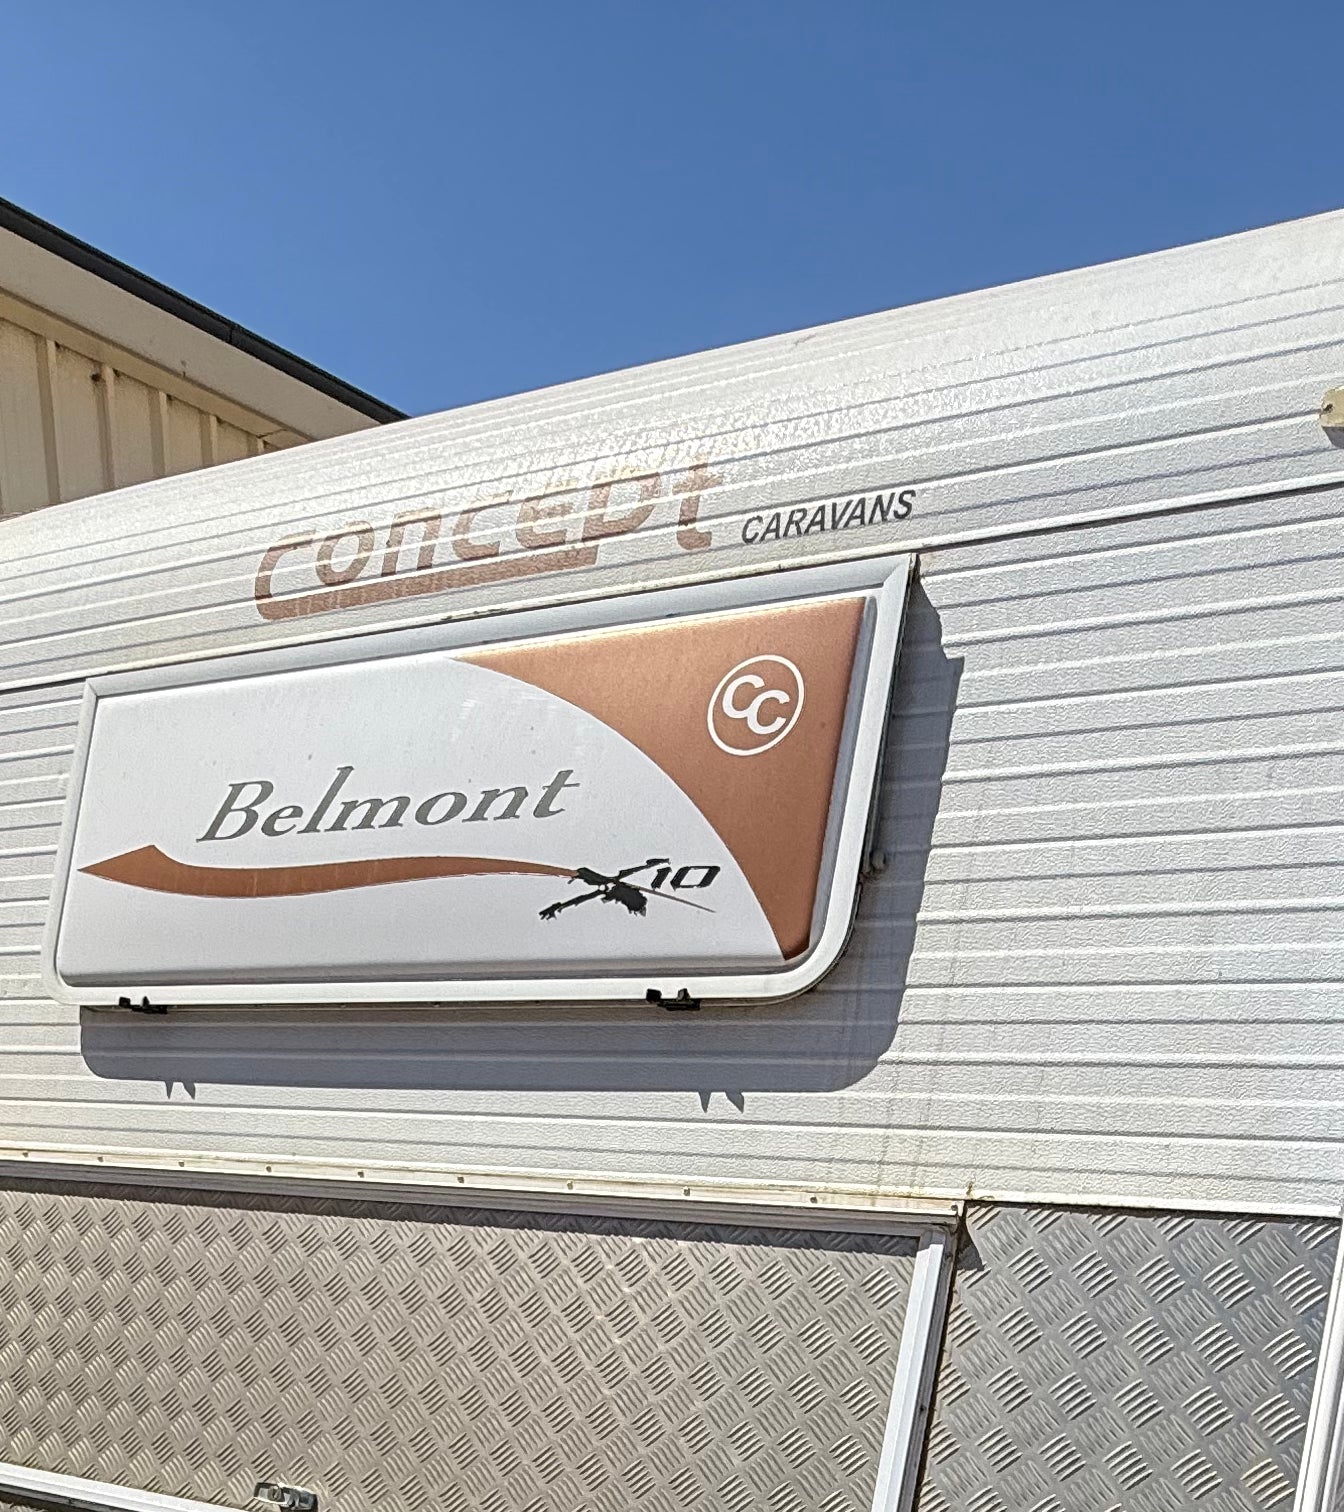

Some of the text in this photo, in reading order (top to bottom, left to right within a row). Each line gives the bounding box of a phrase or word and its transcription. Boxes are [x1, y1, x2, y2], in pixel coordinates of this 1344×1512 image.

[741, 489, 917, 545] CARAVANS
[721, 674, 791, 736] CC
[196, 765, 581, 844] Belmont
